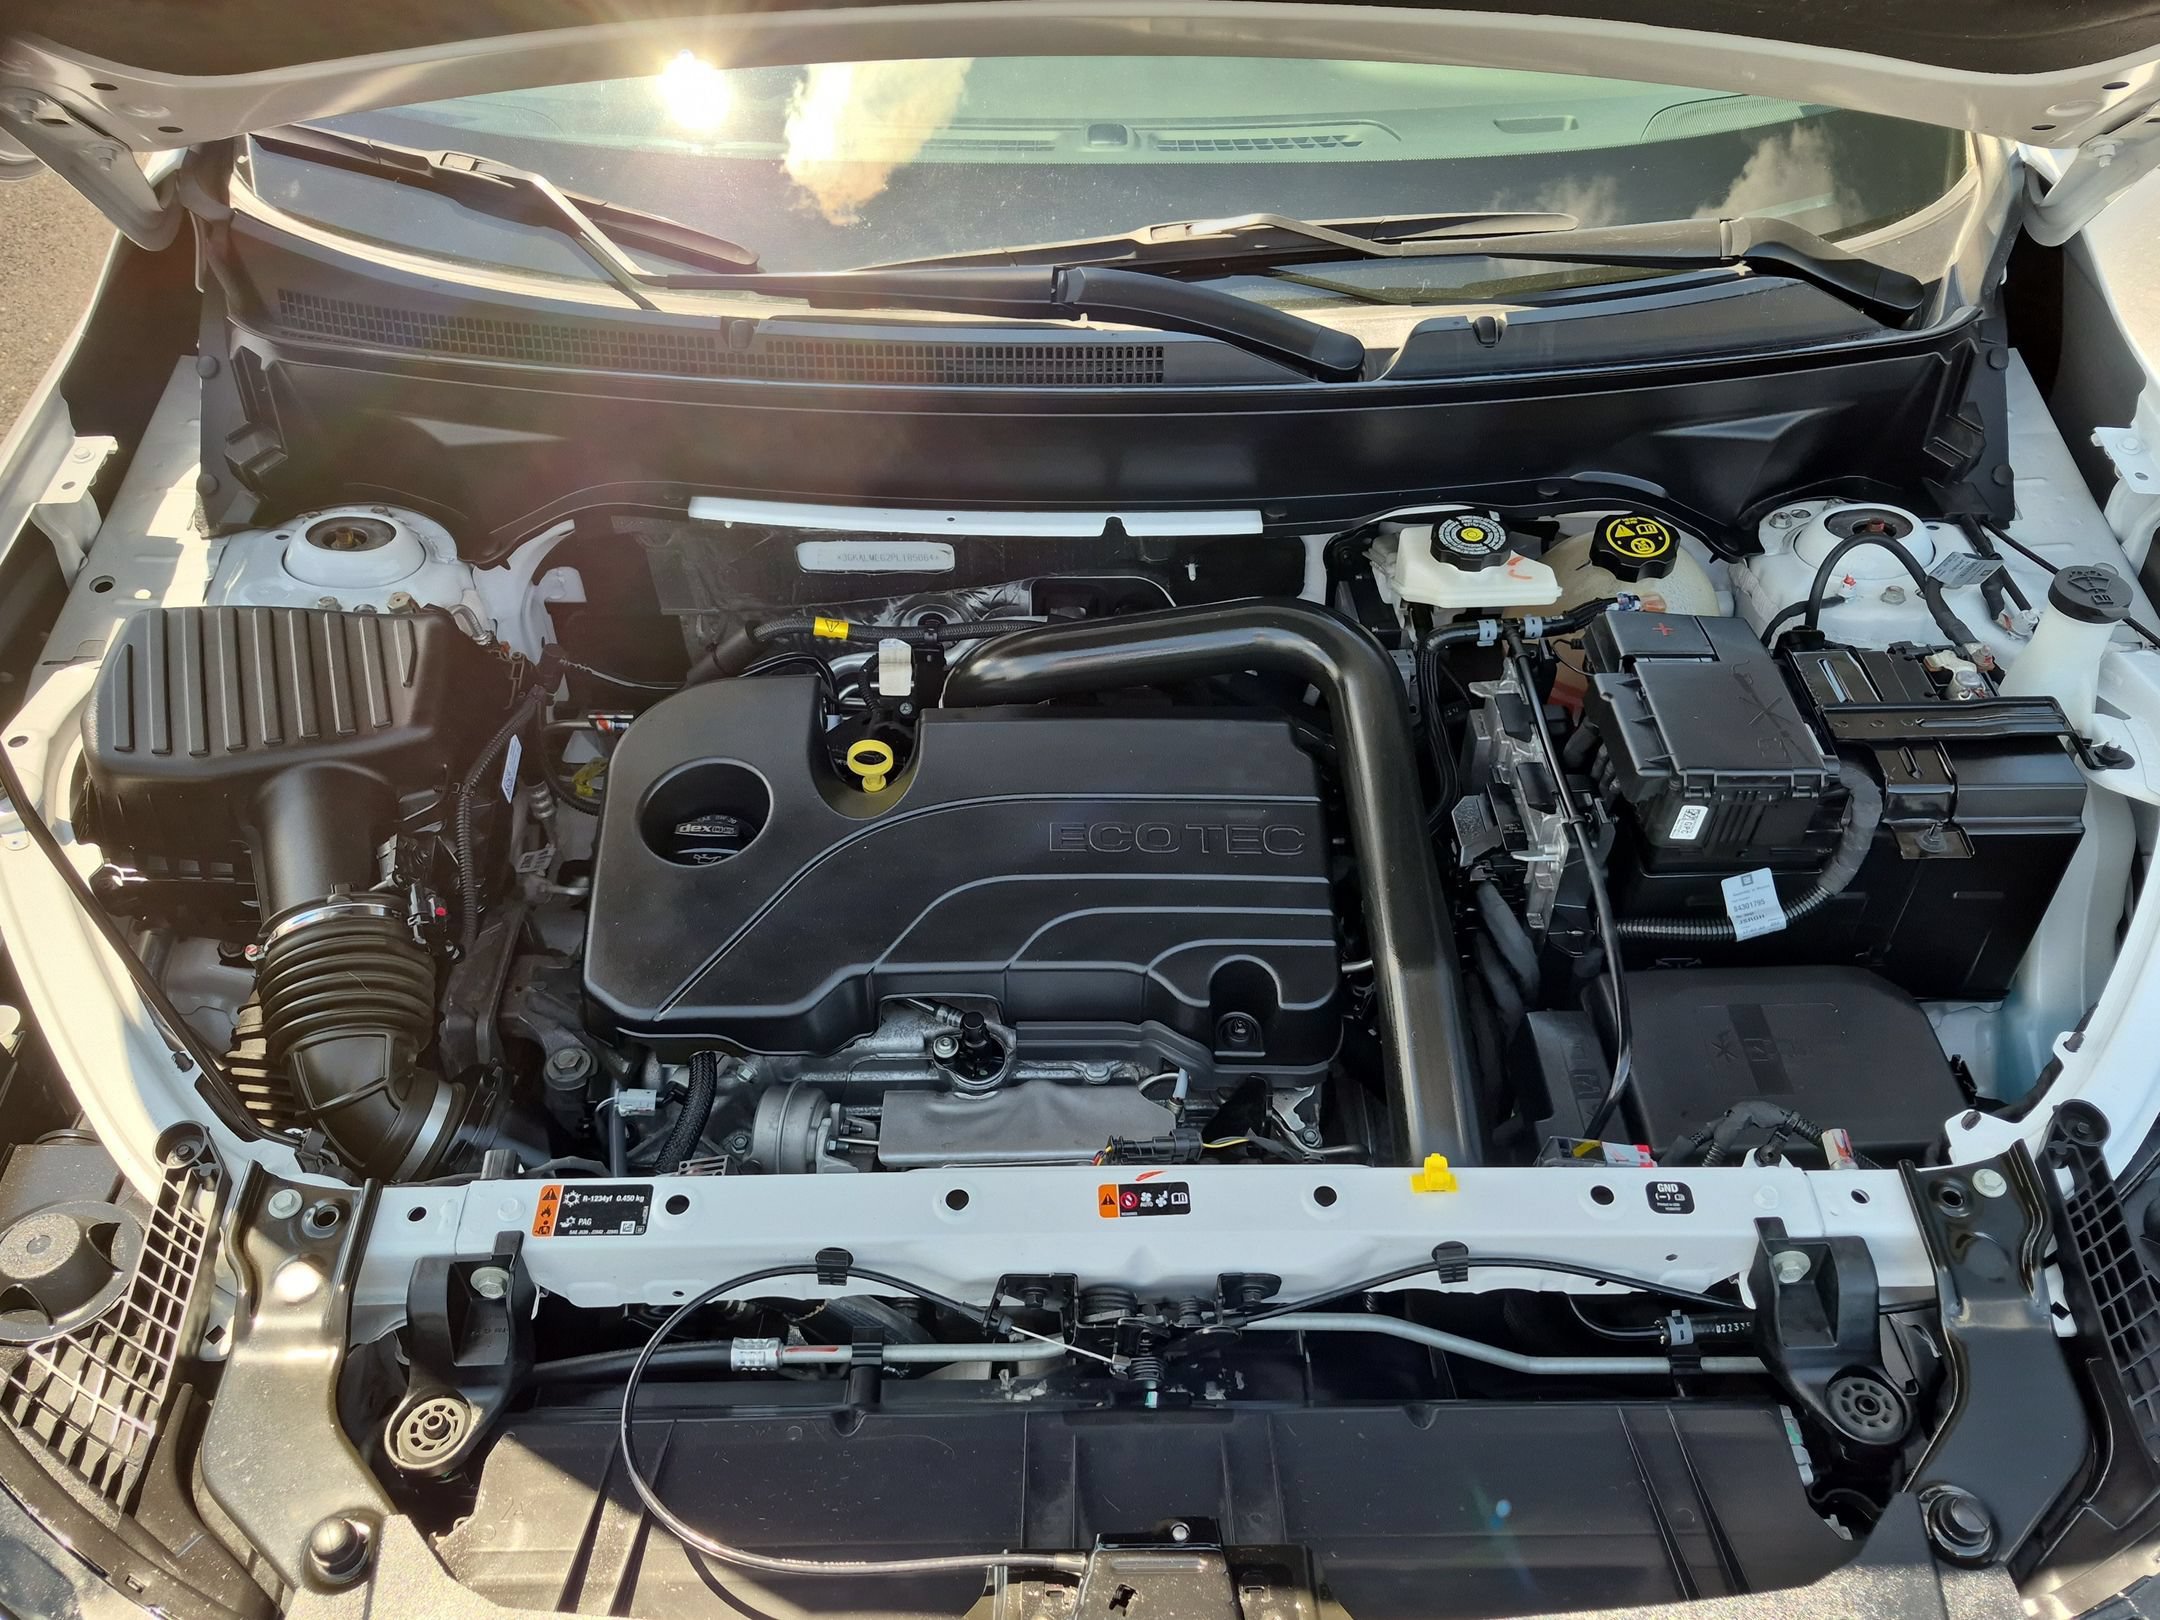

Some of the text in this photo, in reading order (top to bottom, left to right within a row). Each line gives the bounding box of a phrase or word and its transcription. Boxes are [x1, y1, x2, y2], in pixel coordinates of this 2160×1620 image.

[679, 823, 735, 834] dexos
[1049, 822, 1305, 855] ECOTEC
[1656, 1183, 1679, 1193] GND
[582, 1194, 645, 1204] R-1234yf 0.450 kg
[577, 1217, 593, 1226] PAG
